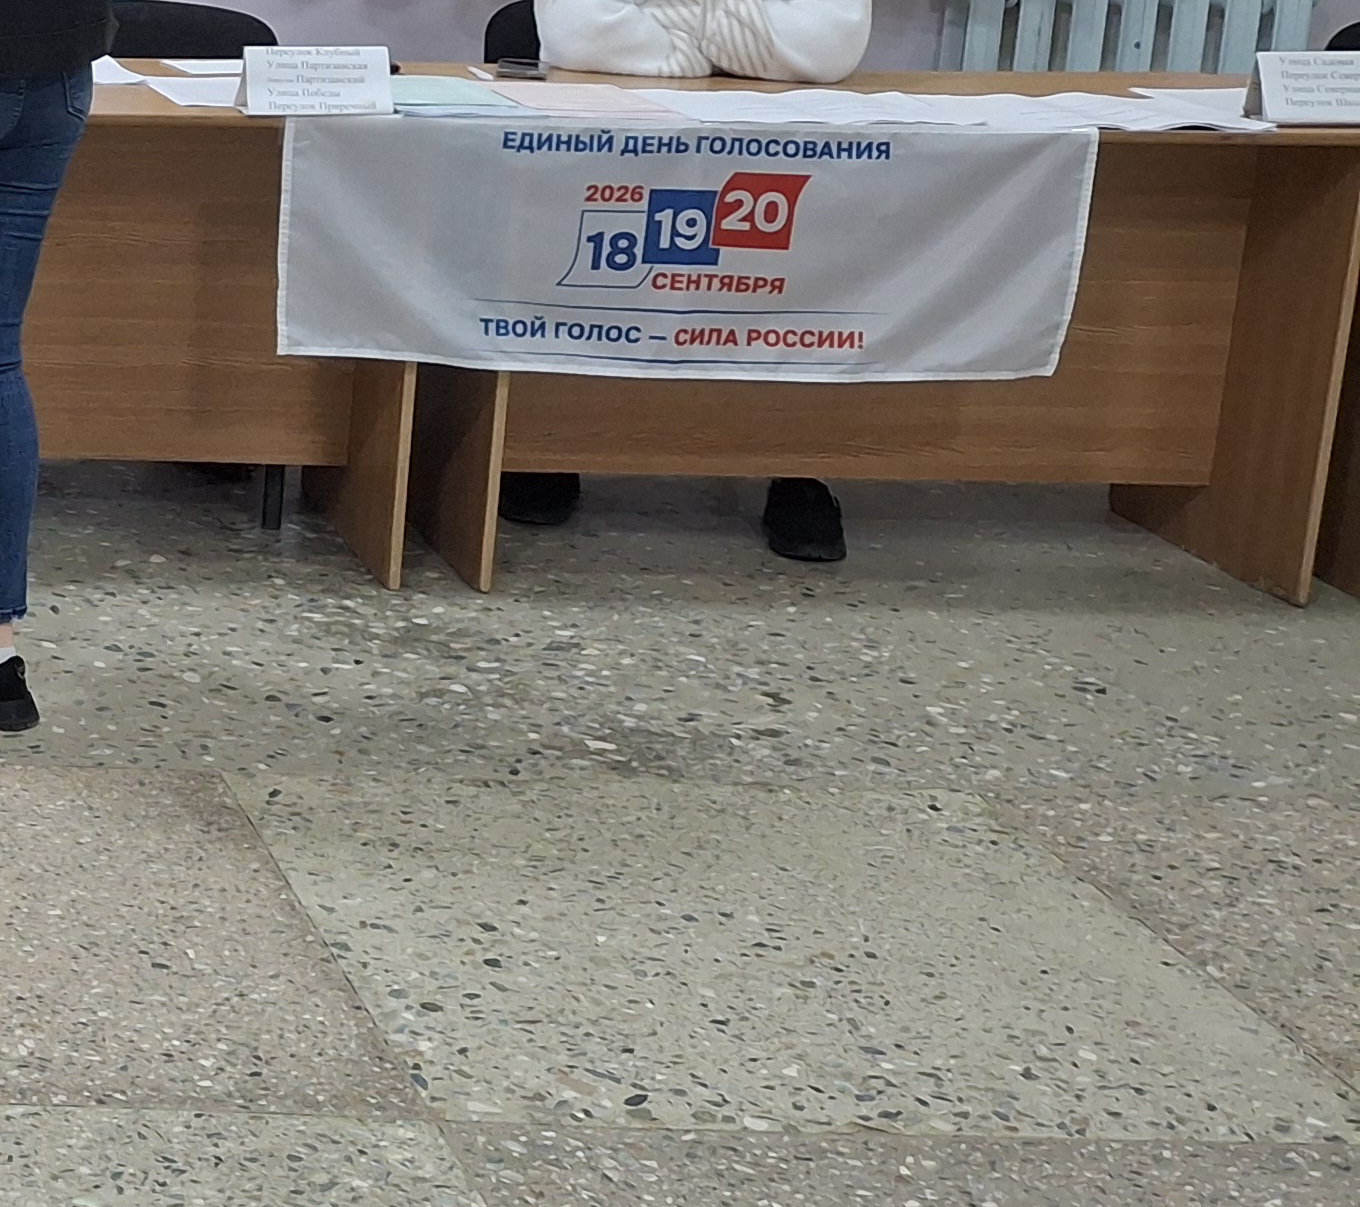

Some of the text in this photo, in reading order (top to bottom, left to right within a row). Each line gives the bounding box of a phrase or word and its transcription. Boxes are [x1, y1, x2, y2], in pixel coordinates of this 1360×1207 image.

[502, 129, 891, 161] ЕДИНЫЙ ДЕНЬ ГОЛОСОВАНИЯ
[584, 184, 645, 203] 2026
[586, 189, 789, 272] 18 19 20
[651, 272, 786, 295] СЕНТЯБРЯ
[480, 315, 547, 339] ТВОЙ
[554, 322, 642, 344] ГОЛОС
[674, 328, 739, 347] СИЛА
[746, 328, 864, 350] РОССИИ!
